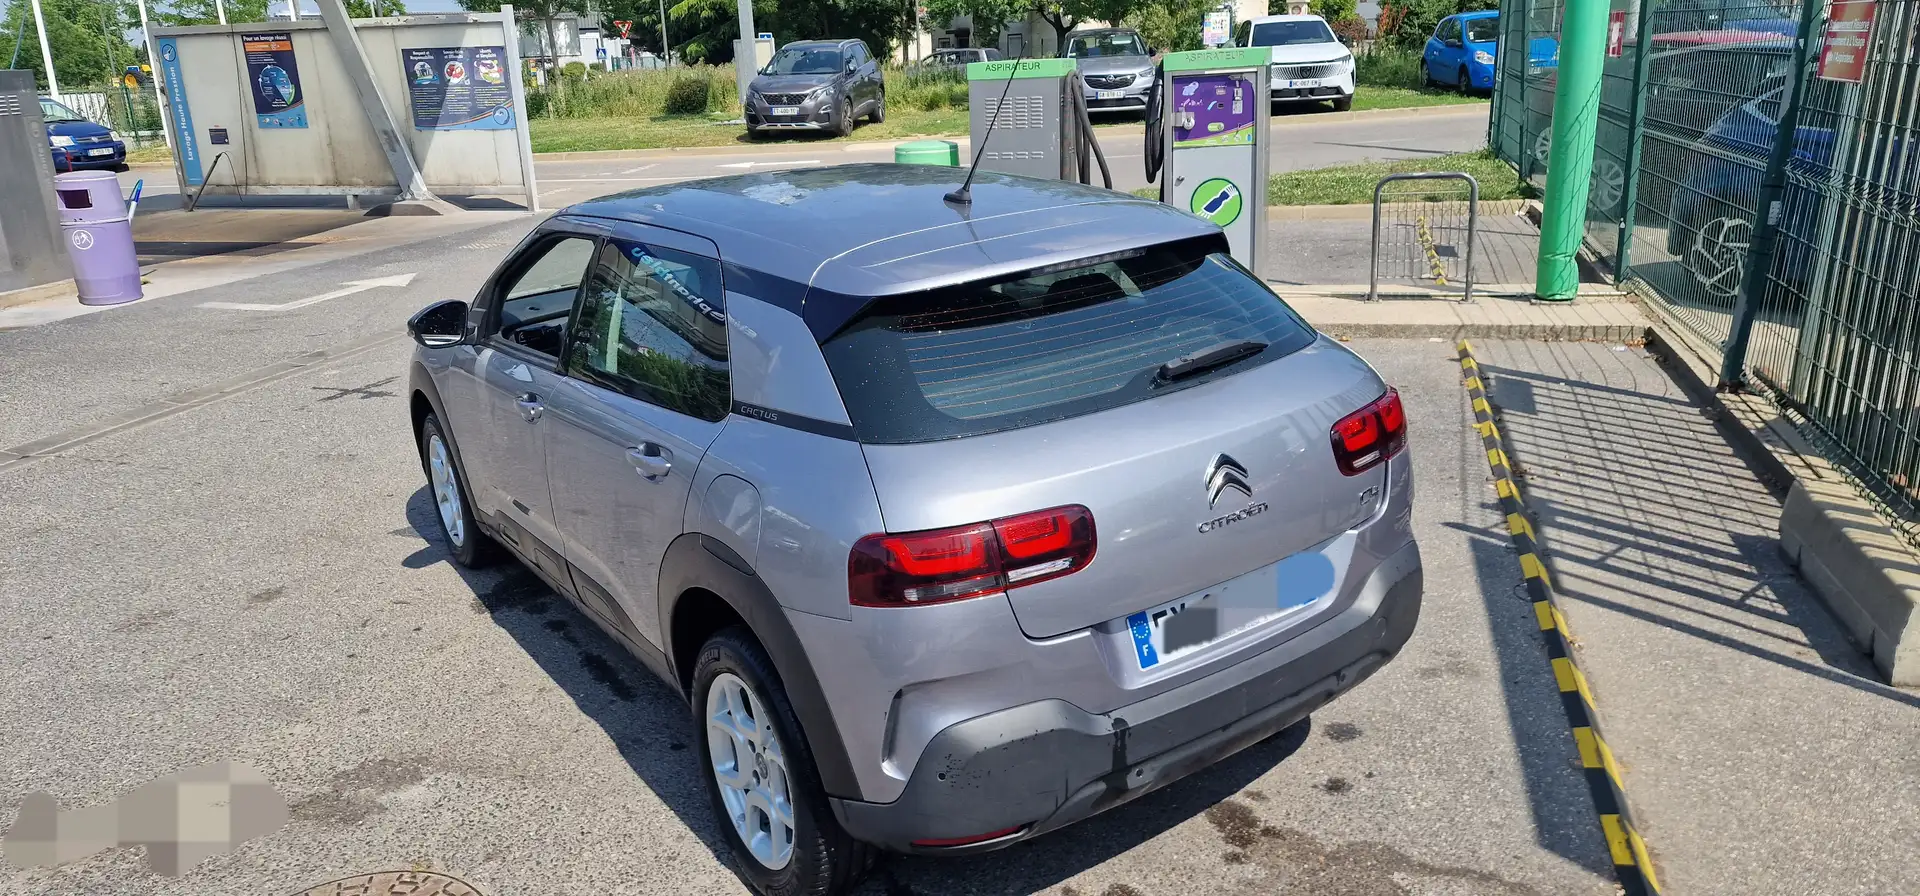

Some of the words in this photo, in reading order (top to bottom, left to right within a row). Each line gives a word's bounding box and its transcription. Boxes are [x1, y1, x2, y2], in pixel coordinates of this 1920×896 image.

[1185, 50, 1245, 62] ASPIRATEUR
[985, 62, 1041, 72] ASPIRATEUR
[170, 66, 182, 102] Pression
[178, 104, 187, 129] Haute
[183, 131, 194, 161] Lavage
[740, 405, 778, 421] CACTUS
[1142, 644, 1150, 657] F
